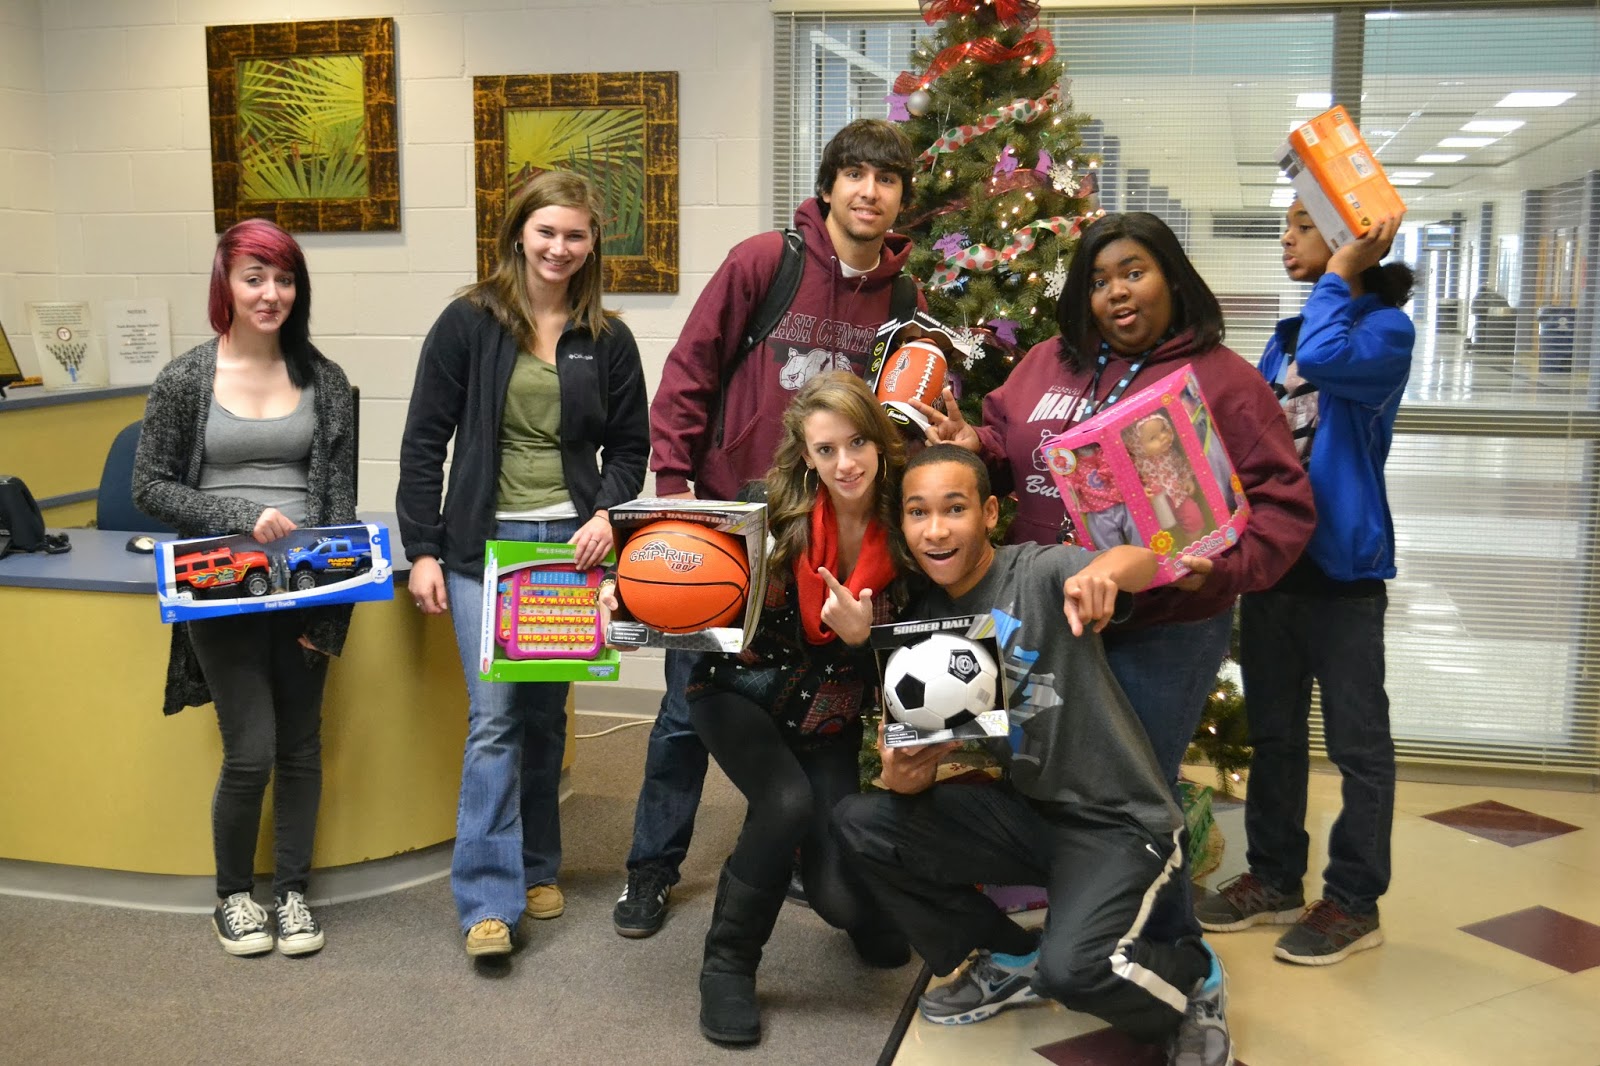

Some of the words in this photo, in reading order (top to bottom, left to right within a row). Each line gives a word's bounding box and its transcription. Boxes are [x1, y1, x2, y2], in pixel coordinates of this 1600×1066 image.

[916, 310, 942, 328] JUNIOR
[816, 319, 876, 354] CENTR
[1026, 392, 1103, 424] MAR
[613, 512, 665, 522] OFFICIAL
[666, 512, 741, 527] BASKETBALL
[327, 556, 355, 564] RACING
[630, 548, 703, 565] GRIP-RITE
[264, 601, 278, 609] Fast
[278, 600, 297, 608] Trucks
[893, 621, 940, 635] SOCCER
[941, 618, 972, 630] BALL
